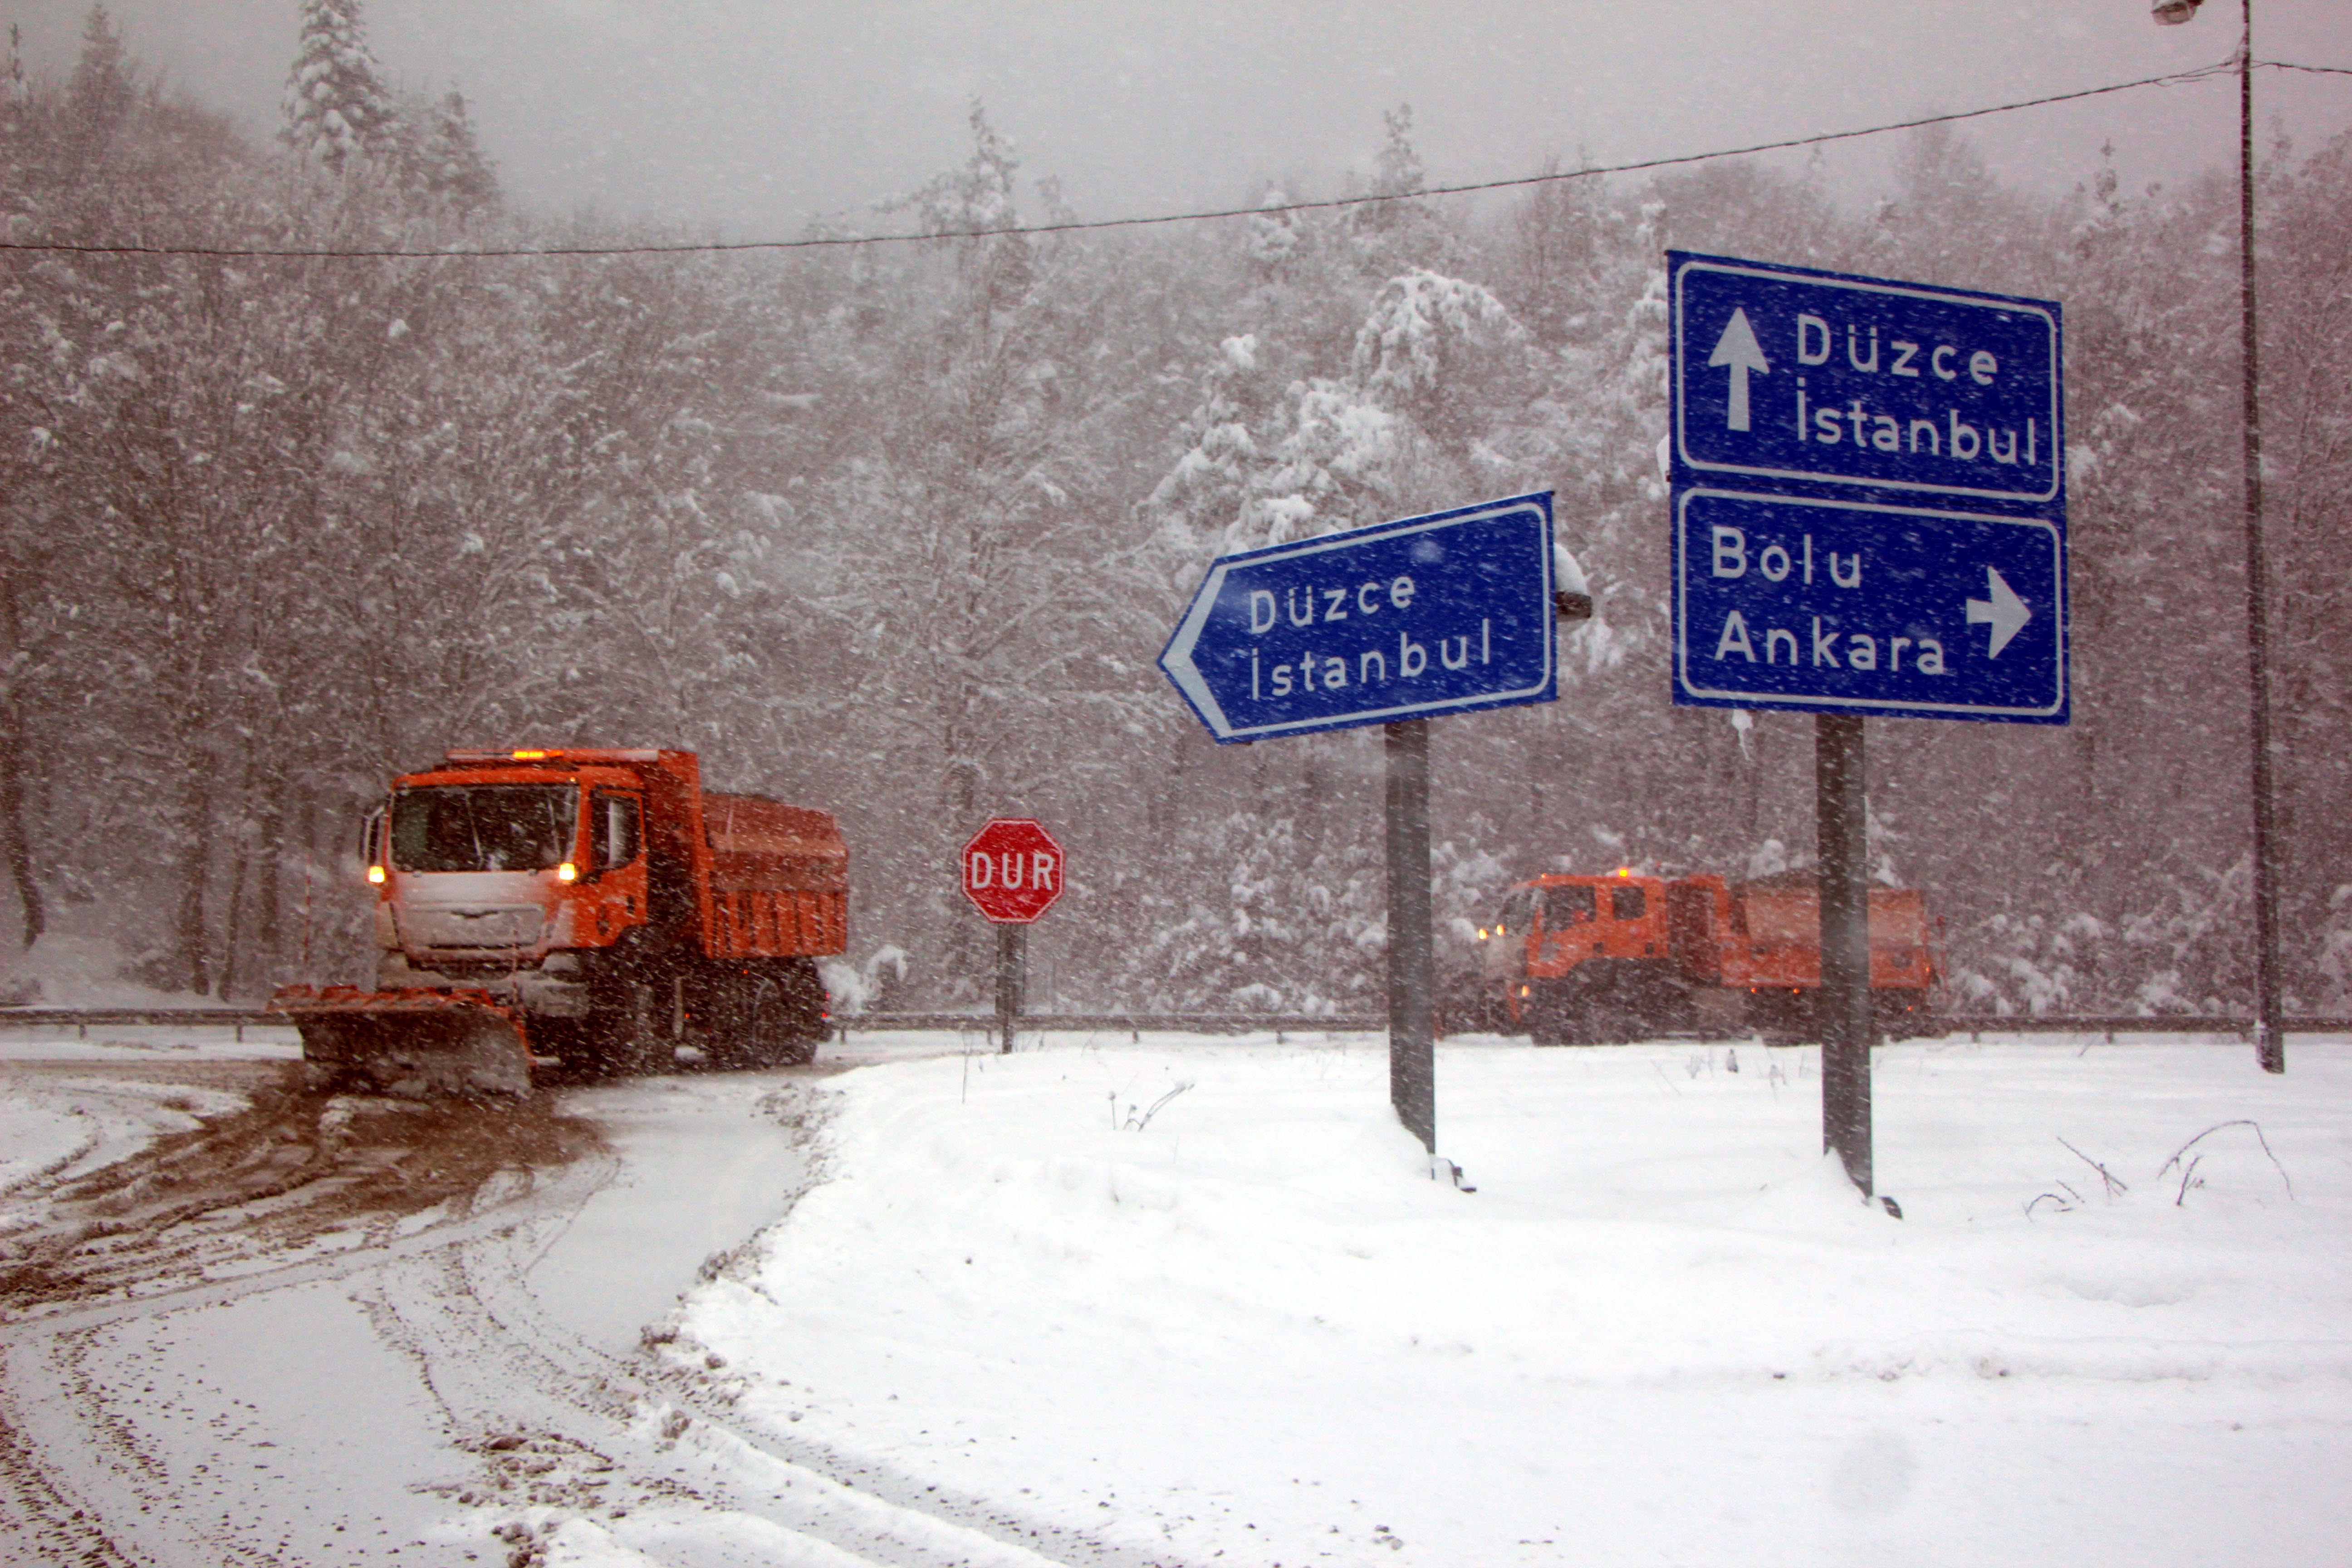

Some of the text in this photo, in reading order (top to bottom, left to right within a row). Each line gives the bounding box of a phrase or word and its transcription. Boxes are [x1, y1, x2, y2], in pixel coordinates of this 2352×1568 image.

[1797, 313, 1998, 385] Düzce
[1797, 377, 2035, 465] İstanbul
[1712, 525, 1860, 588] Bolu
[1250, 576, 1415, 634] Düzce
[1252, 618, 1489, 701] İstanbul
[1714, 610, 1945, 675] Ankara
[971, 852, 1054, 890] DUR
